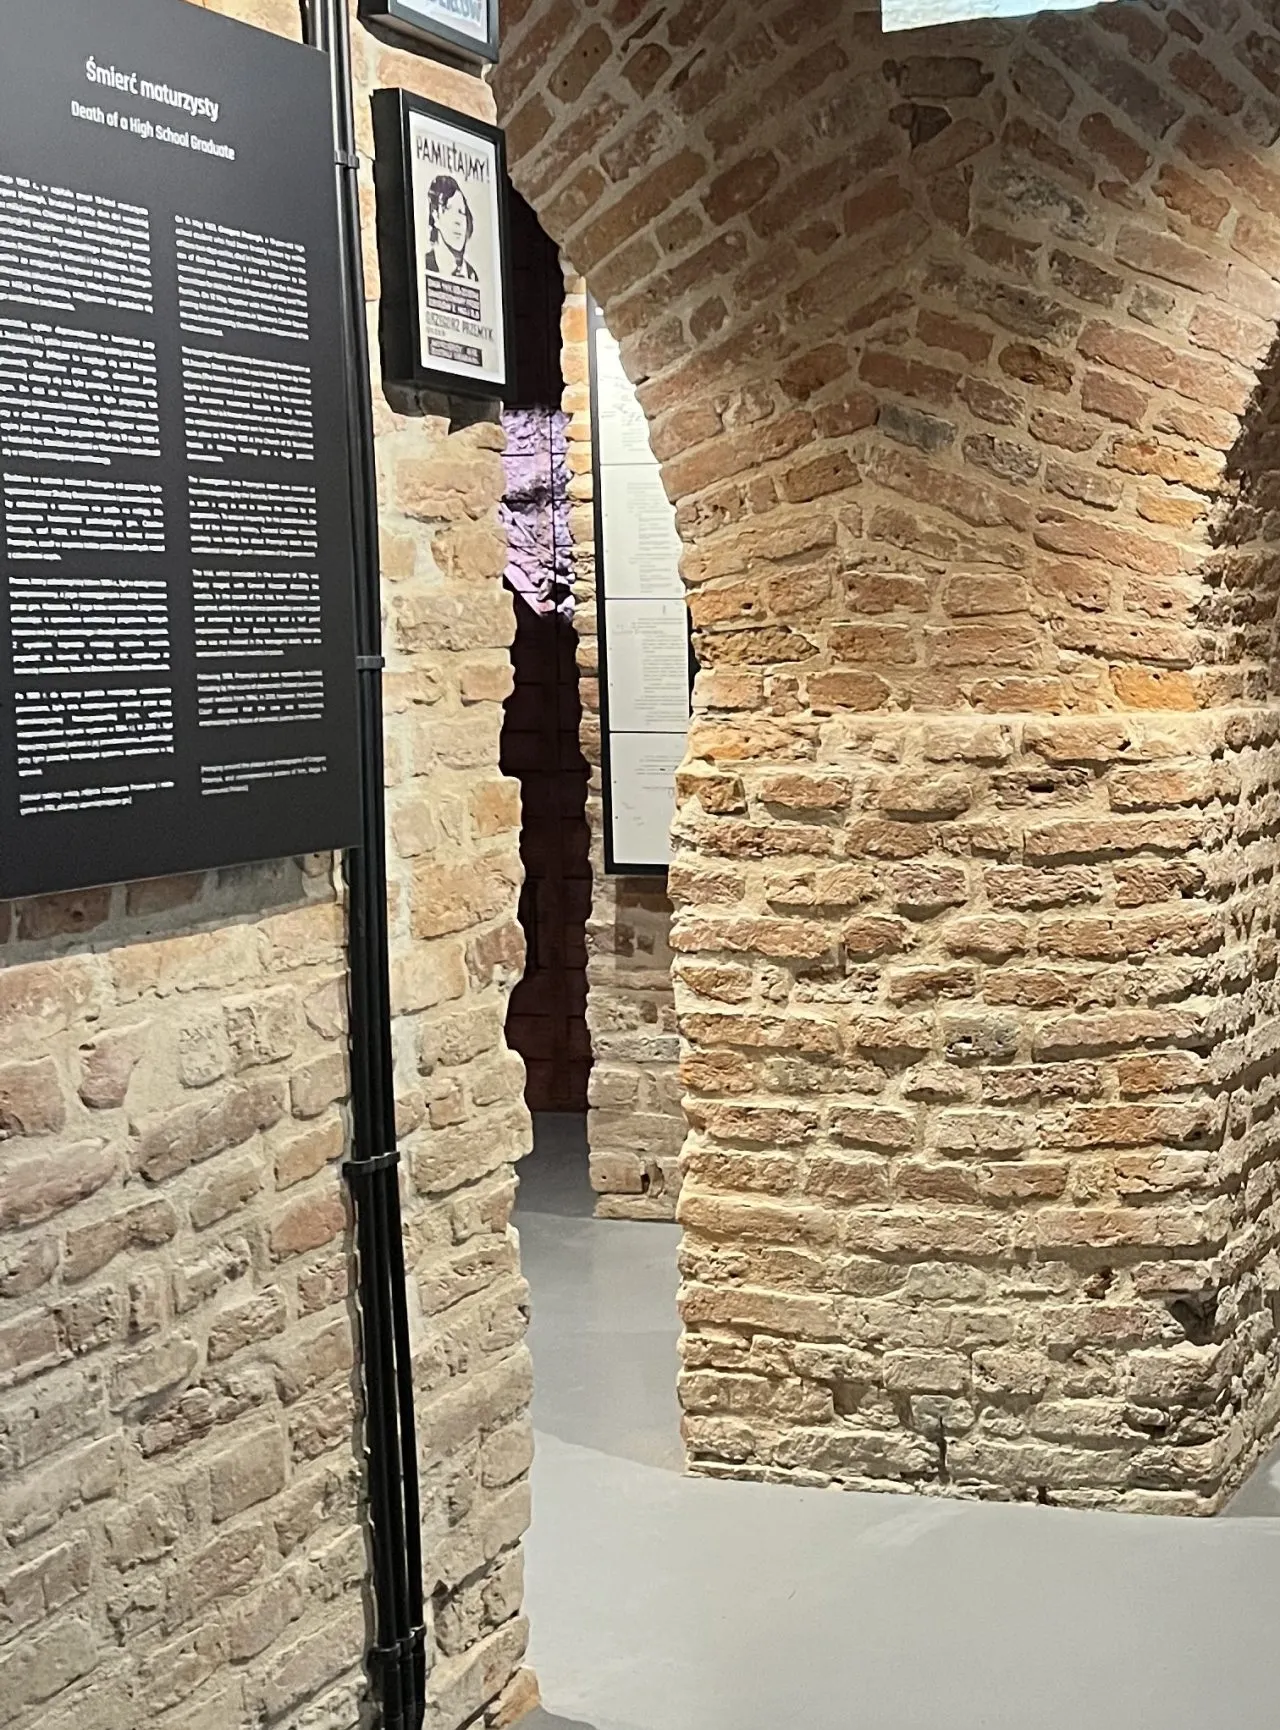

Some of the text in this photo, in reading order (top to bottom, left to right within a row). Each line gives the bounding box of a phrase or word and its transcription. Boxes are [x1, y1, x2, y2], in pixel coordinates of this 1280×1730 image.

[86, 55, 220, 122] Śmierć maturzysty
[71, 100, 236, 161] Death of a High School Graduate
